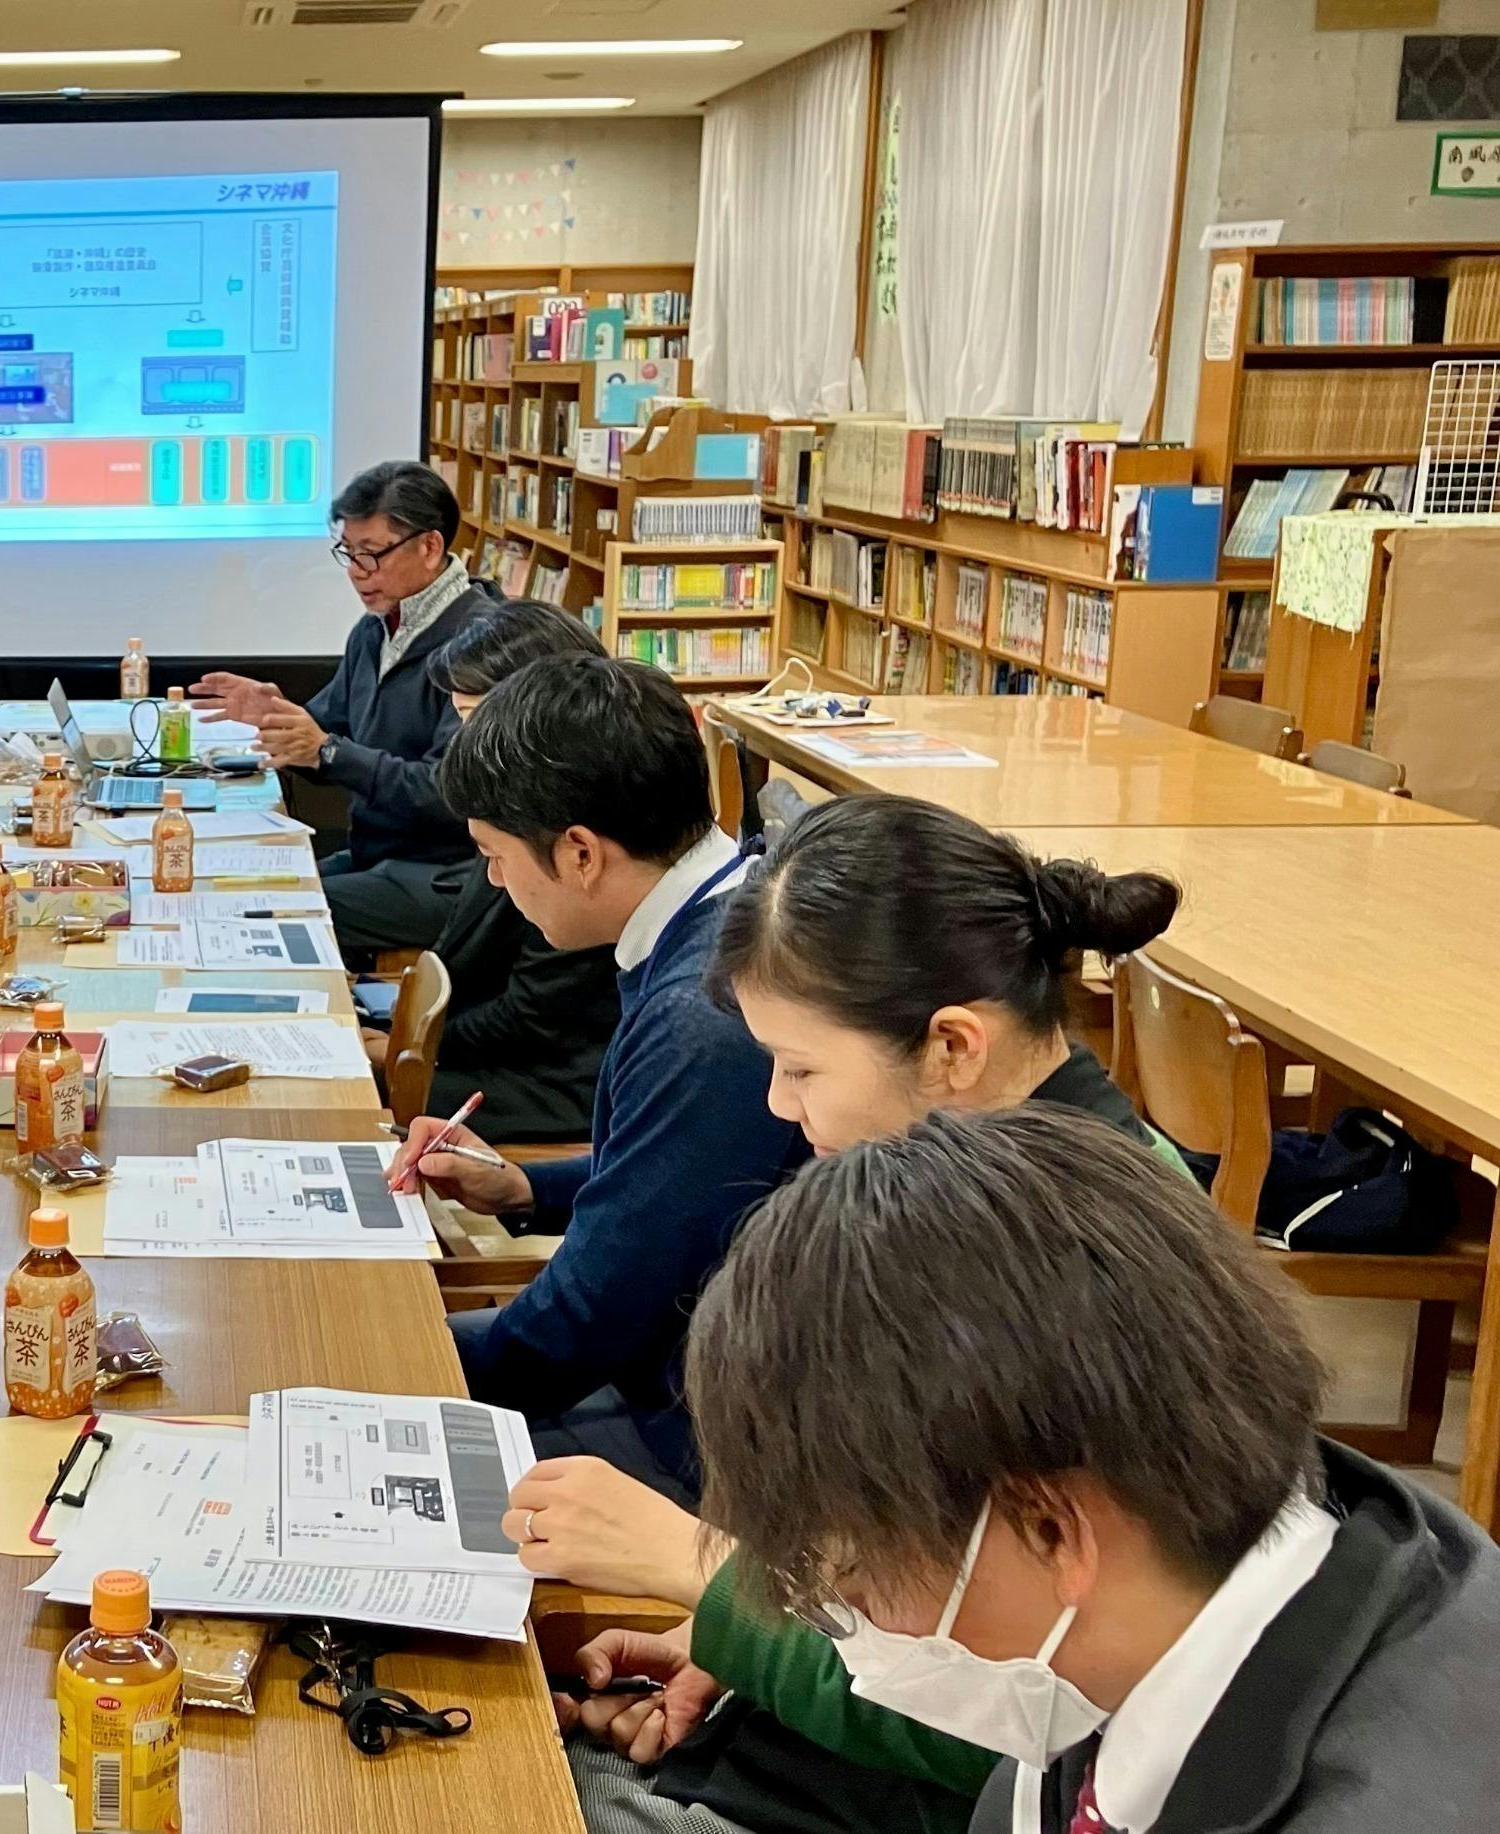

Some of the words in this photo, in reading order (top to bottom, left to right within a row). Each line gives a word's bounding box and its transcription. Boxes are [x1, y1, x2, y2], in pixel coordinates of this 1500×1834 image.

[216, 180, 311, 202] シネマ沖縄
[168, 854, 185, 868] 茶
[61, 1099, 76, 1122] 茶
[7, 1319, 50, 1342] さんぴん
[15, 1337, 40, 1367] 茶
[73, 1335, 90, 1368] 茶
